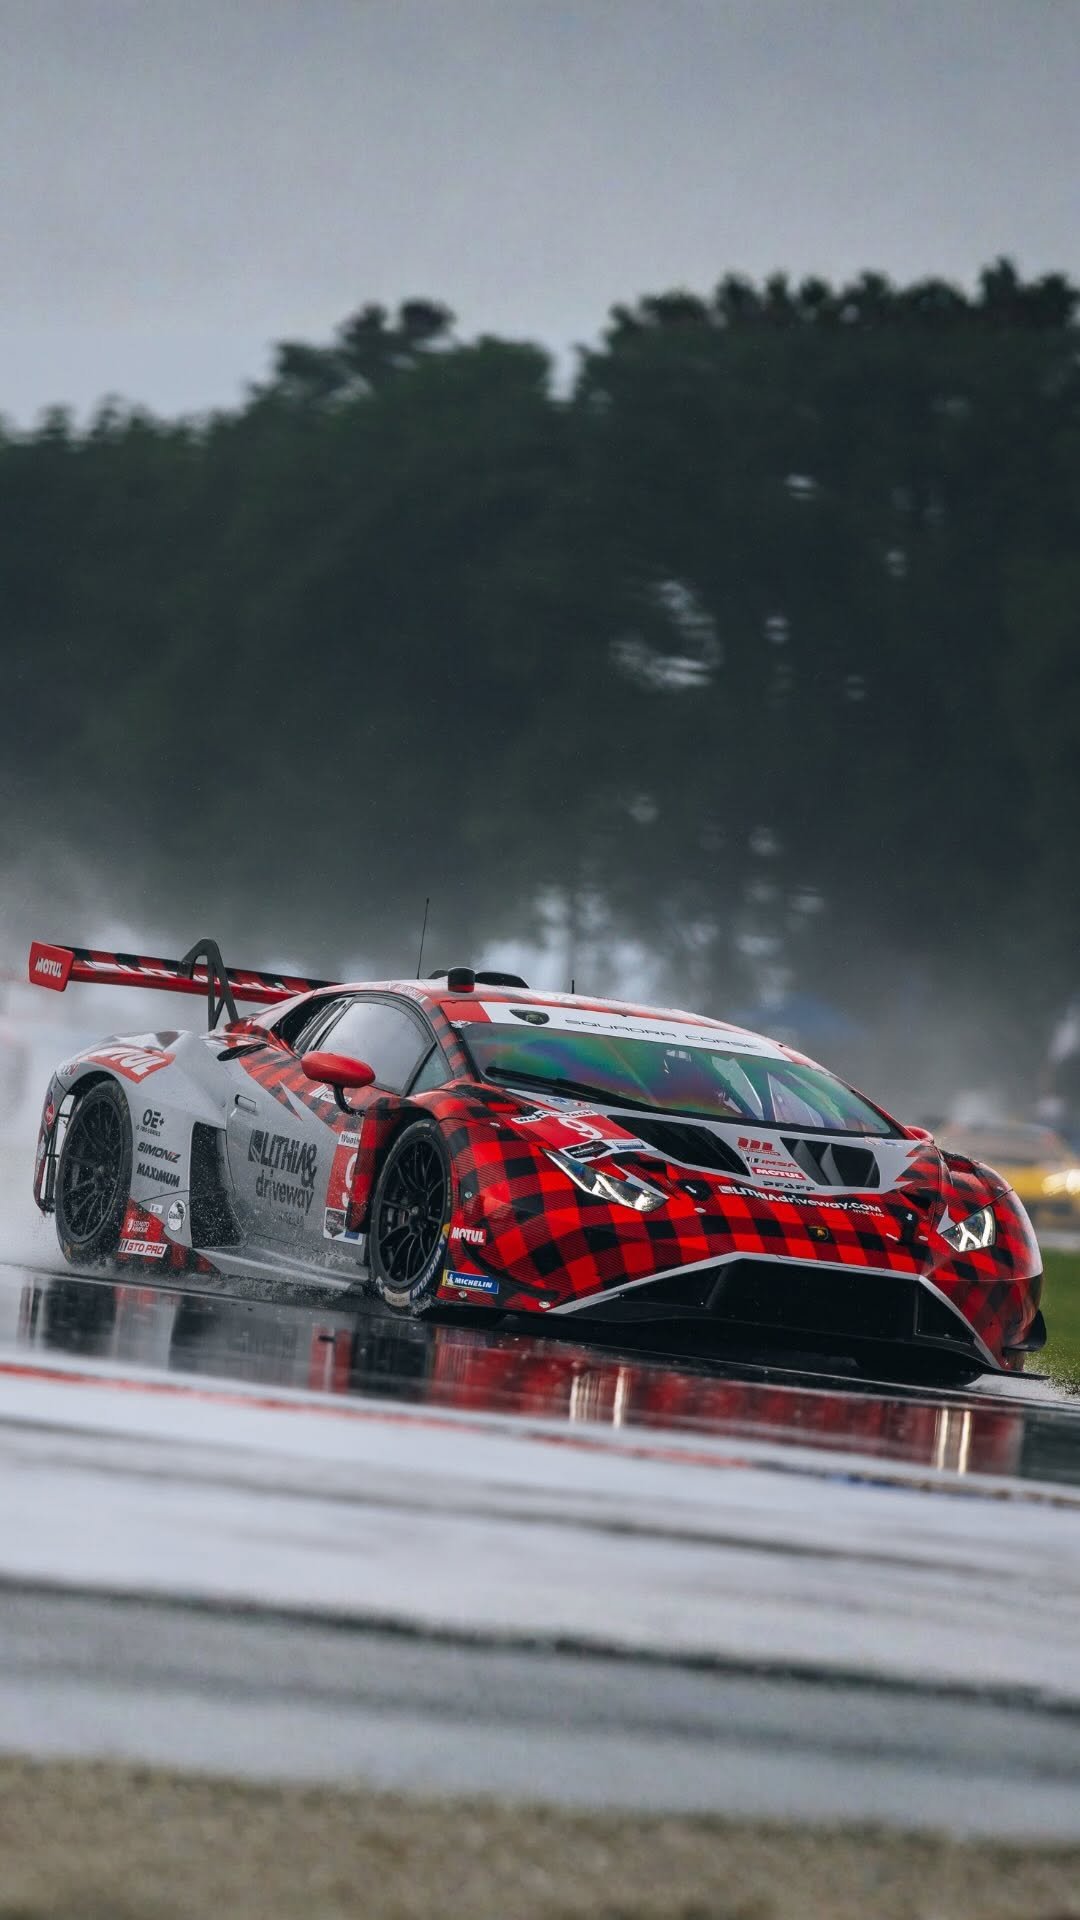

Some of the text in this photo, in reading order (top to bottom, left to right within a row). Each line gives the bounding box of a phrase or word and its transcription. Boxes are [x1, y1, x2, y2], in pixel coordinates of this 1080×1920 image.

[35, 957, 63, 978] MOTUL
[565, 1019, 760, 1050] SQUADRA CORSE
[557, 1117, 603, 1140] 9
[755, 1168, 803, 1180] MOTUL
[761, 1159, 798, 1168] IMSA
[136, 1162, 181, 1188] MAXIMUM
[255, 1169, 314, 1216] driveway
[451, 1227, 486, 1243] MOTUL
[454, 1277, 493, 1289] MICHELIN
